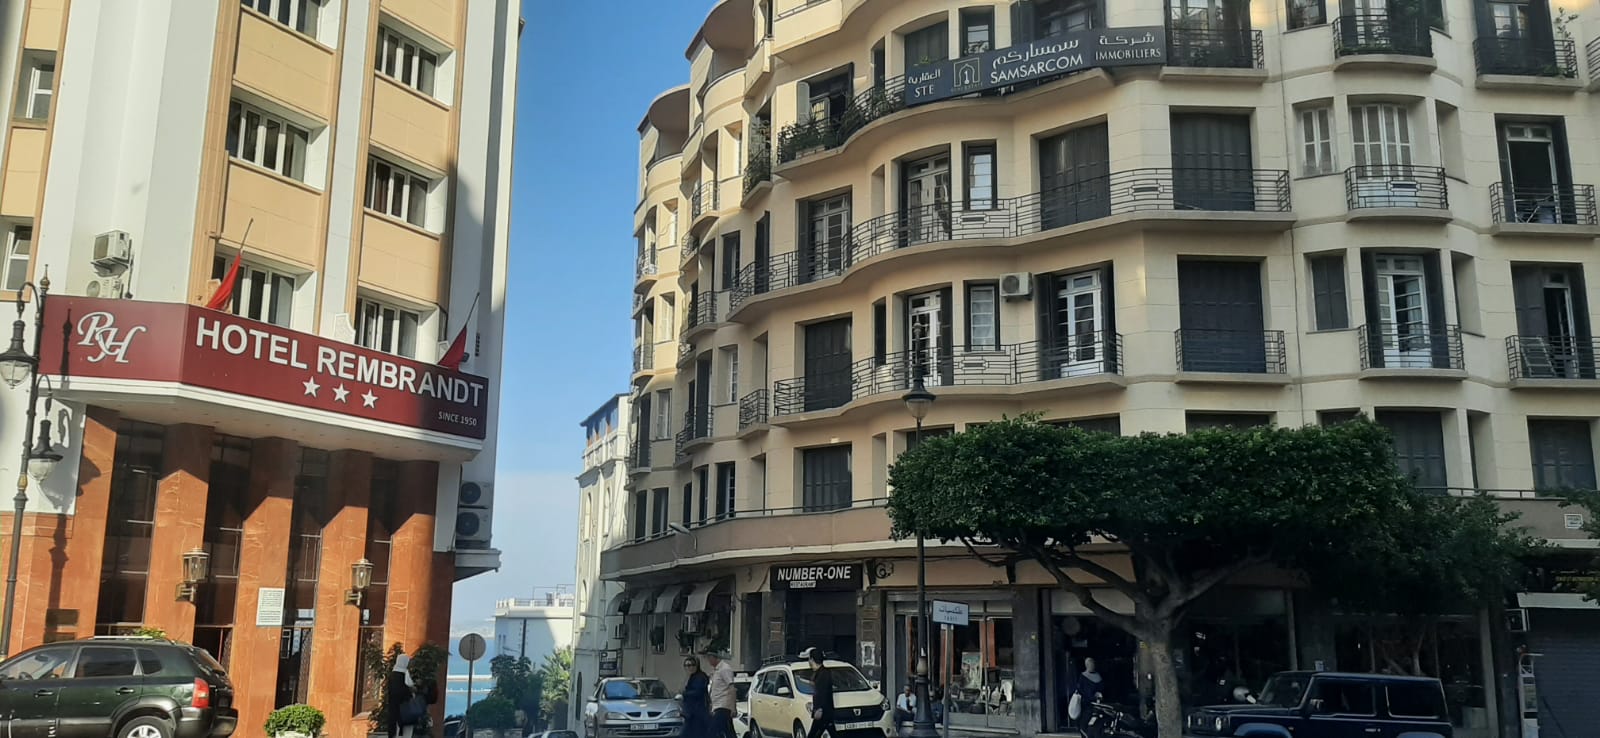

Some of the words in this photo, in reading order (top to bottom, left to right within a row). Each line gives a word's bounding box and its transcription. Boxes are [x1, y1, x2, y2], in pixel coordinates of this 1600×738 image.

[1100, 32, 1155, 46] شركة
[992, 39, 1079, 69] سمساركم
[1095, 48, 1161, 61] IMMOBILIERS
[908, 69, 941, 84] العقارية
[990, 54, 1083, 84] SAMSARCOM
[914, 84, 934, 98] STE
[196, 317, 308, 370] HOTEL
[316, 345, 483, 407] REMBRANDT
[438, 411, 460, 423] SINCE
[460, 416, 478, 426] 1950
[777, 565, 852, 581] NUMBER-ONE
